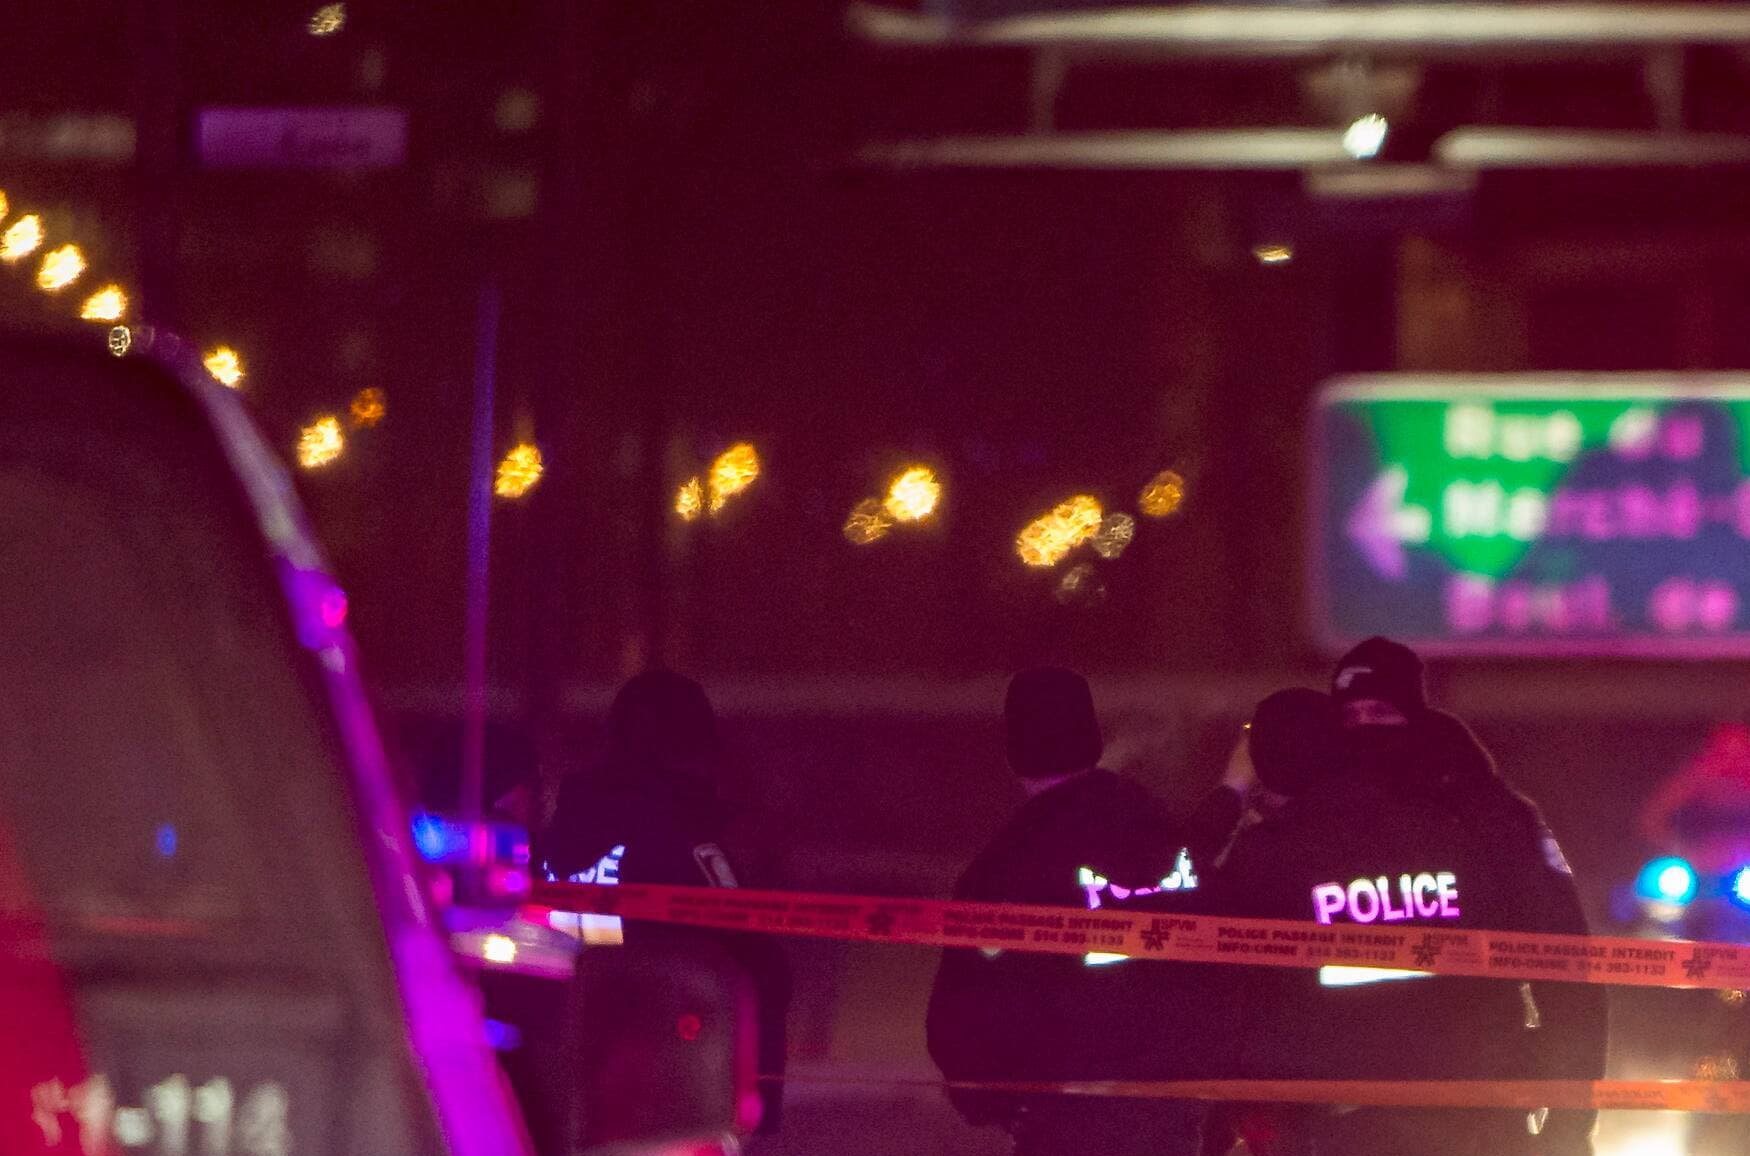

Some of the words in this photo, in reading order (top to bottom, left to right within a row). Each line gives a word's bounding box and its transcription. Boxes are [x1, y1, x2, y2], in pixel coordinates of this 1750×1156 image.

[1311, 871, 1460, 925] POLICE
[1488, 940, 1539, 955] POLICE
[1542, 943, 1606, 958] PASSAGE
[1611, 947, 1676, 962] INTERDIT
